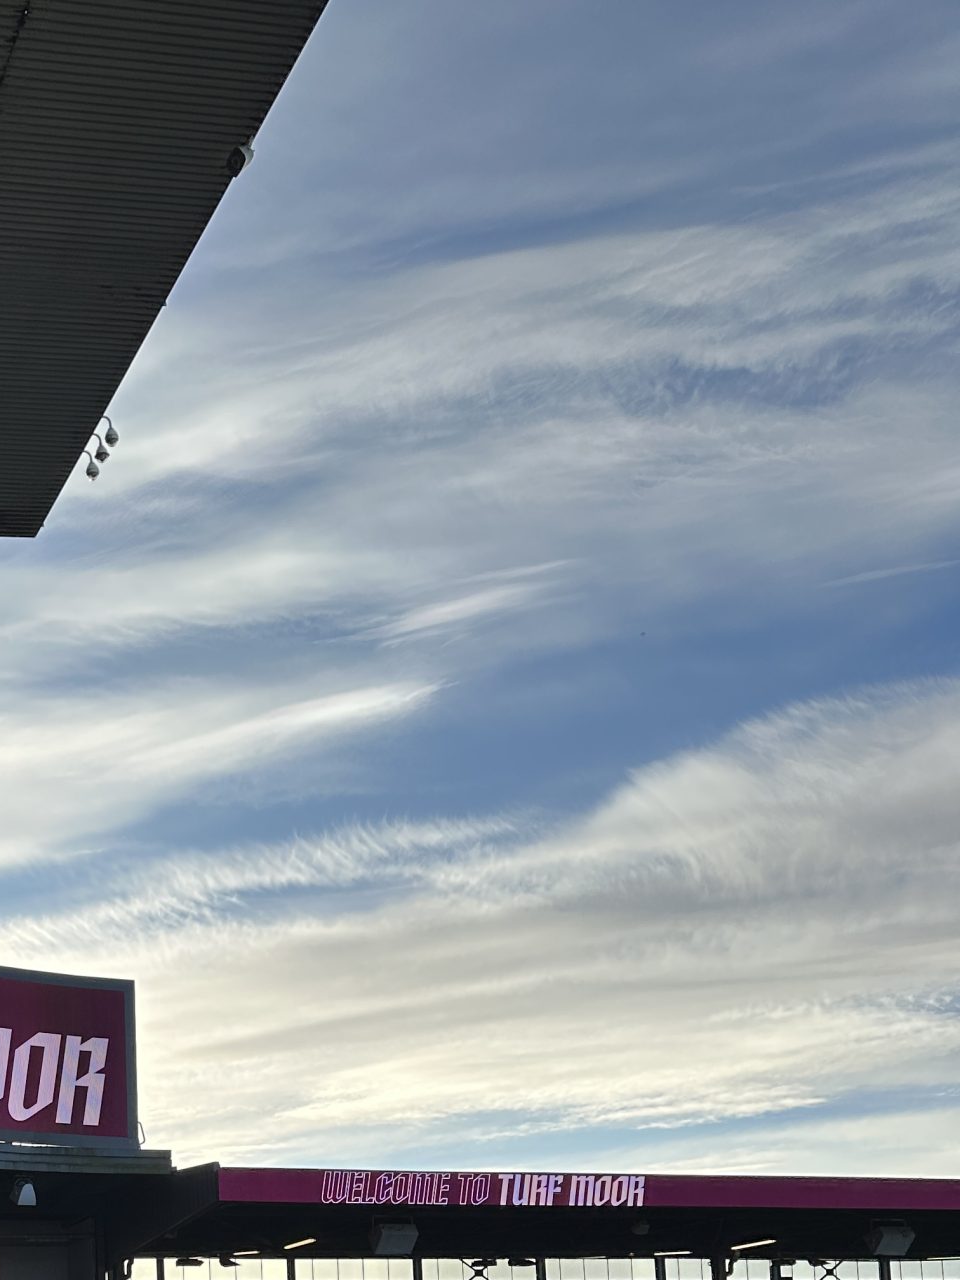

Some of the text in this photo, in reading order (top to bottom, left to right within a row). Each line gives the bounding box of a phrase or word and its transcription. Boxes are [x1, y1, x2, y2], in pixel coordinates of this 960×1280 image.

[321, 1171, 646, 1208] WELCOME TO TURF MOOR
